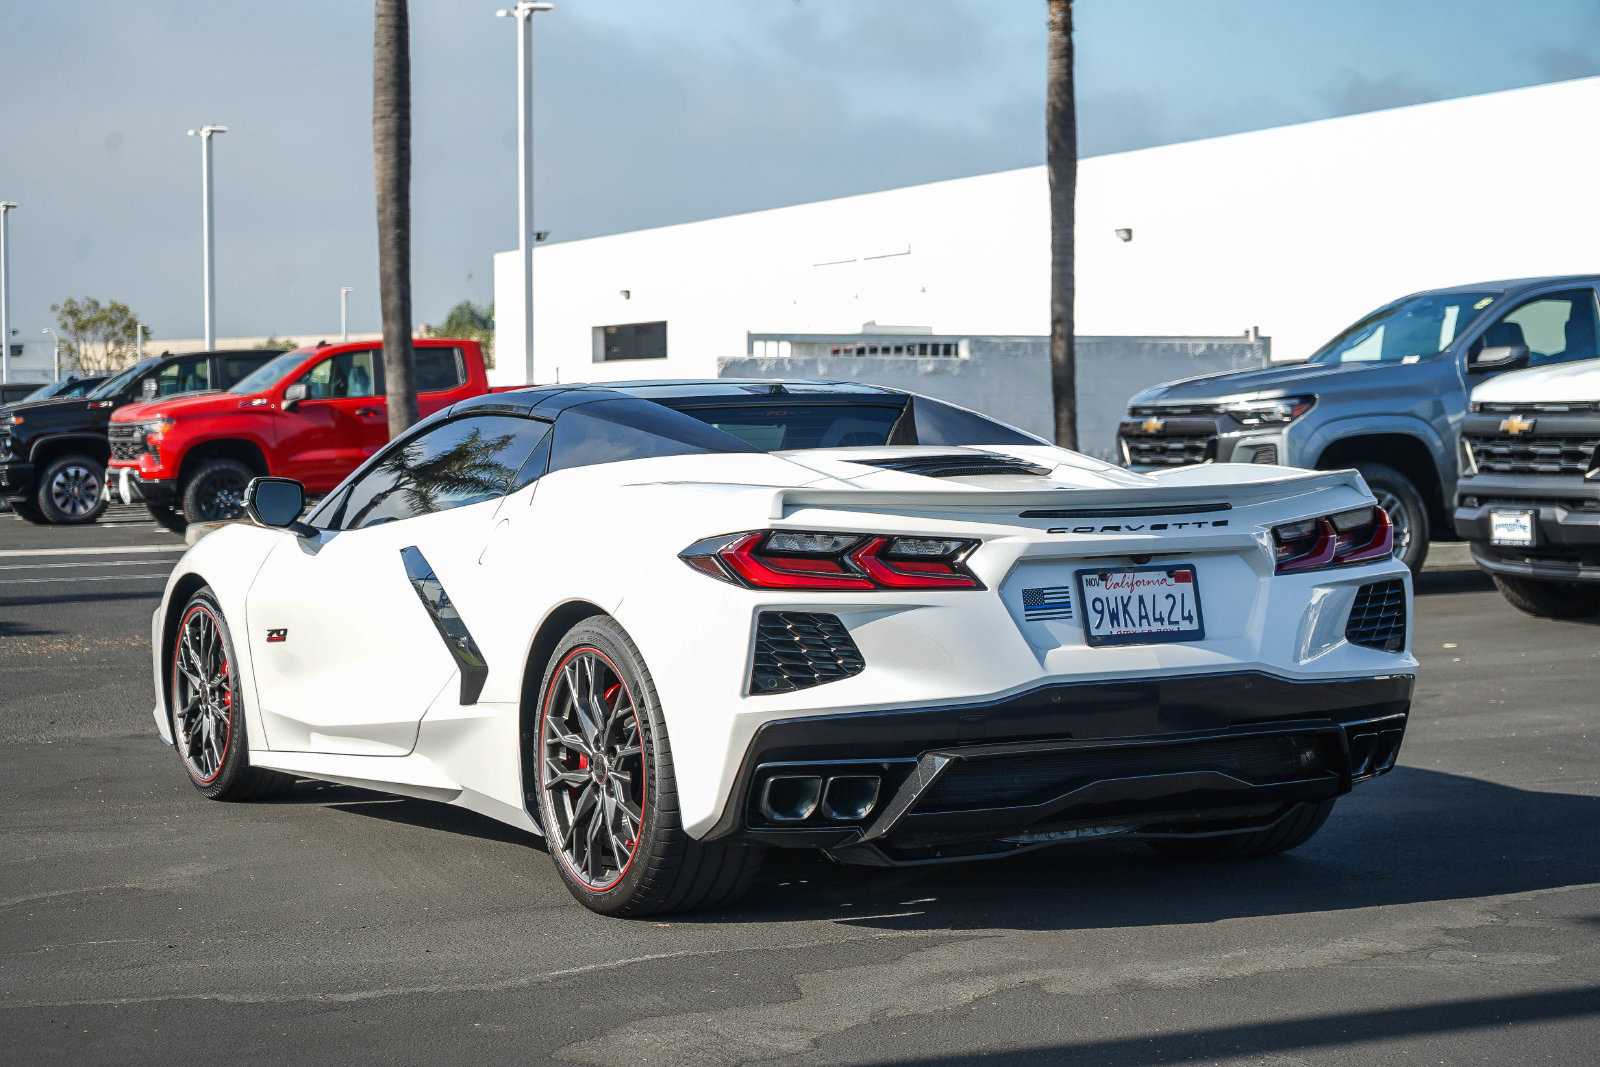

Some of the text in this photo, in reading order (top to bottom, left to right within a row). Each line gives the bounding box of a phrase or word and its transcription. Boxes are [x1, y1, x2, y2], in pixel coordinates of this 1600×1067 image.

[1046, 520, 1228, 533] CORVETTE
[1085, 577, 1100, 587] NOV
[1104, 573, 1175, 593] California
[1091, 593, 1194, 630] 9WKA424
